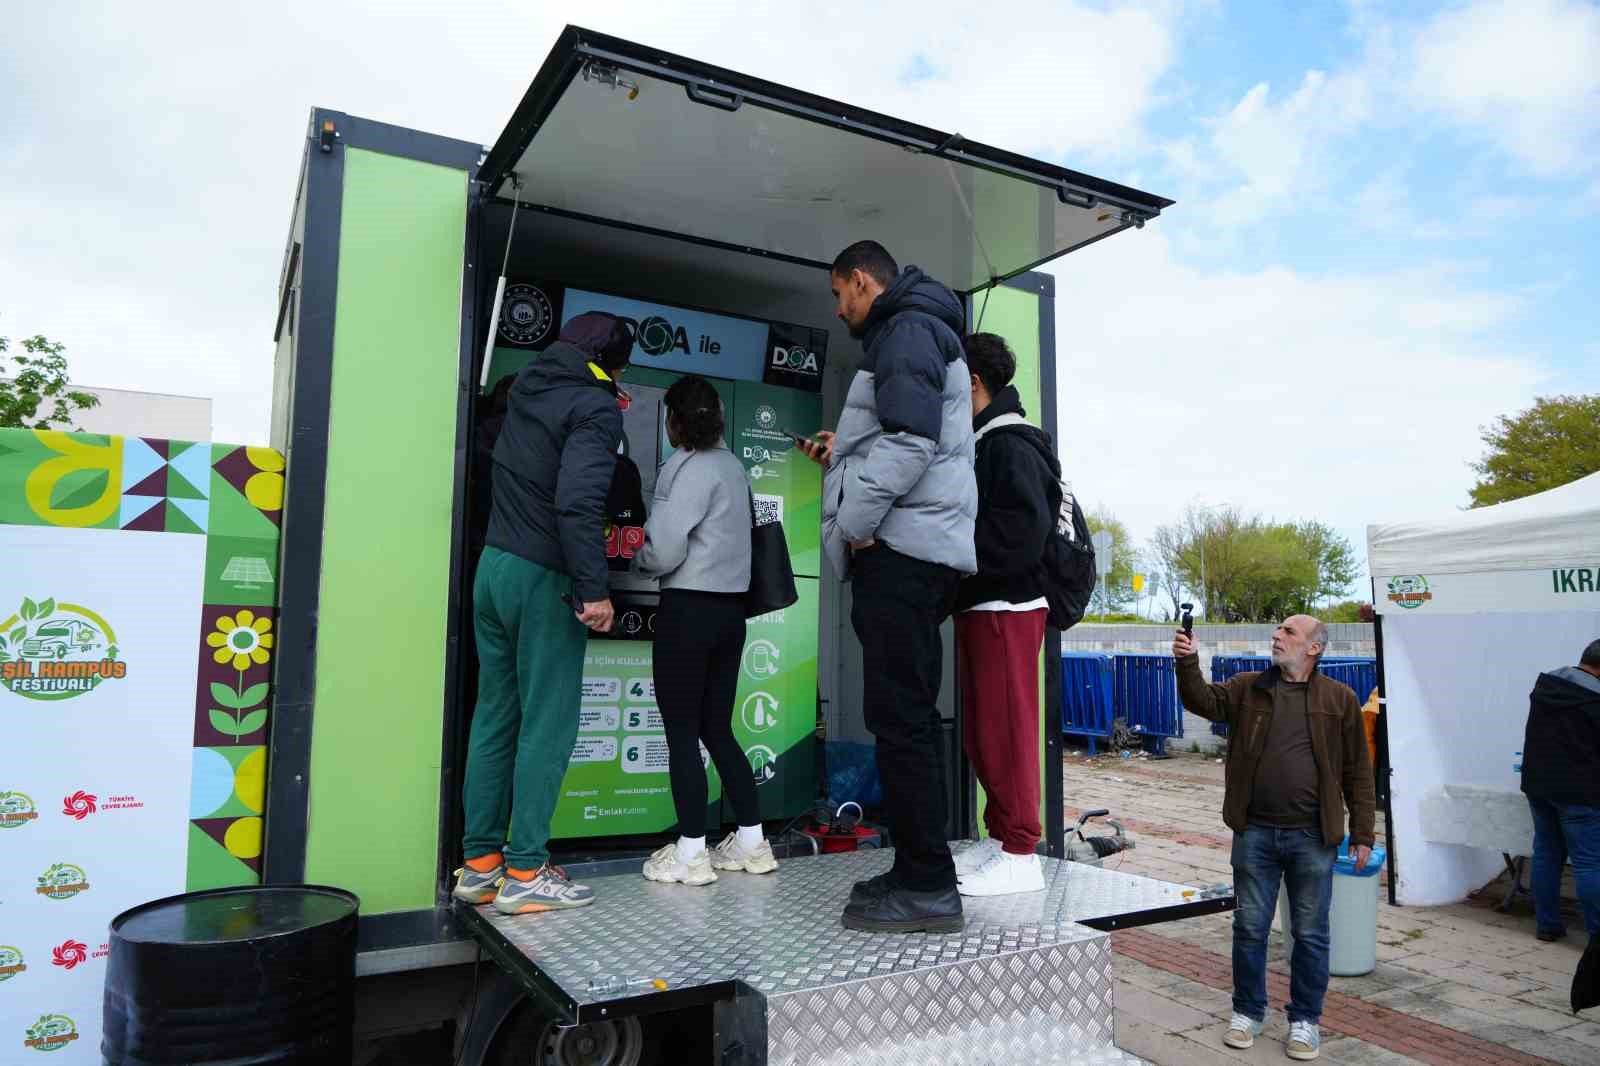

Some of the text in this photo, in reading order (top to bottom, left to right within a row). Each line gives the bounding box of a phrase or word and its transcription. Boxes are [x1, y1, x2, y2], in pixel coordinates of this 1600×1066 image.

[699, 335, 721, 354] ile
[773, 346, 818, 371] DOA
[743, 446, 770, 462] DOA
[1552, 567, 1600, 593] IKR
[630, 682, 643, 696] 4
[628, 712, 641, 727] 5
[626, 747, 639, 762] 6
